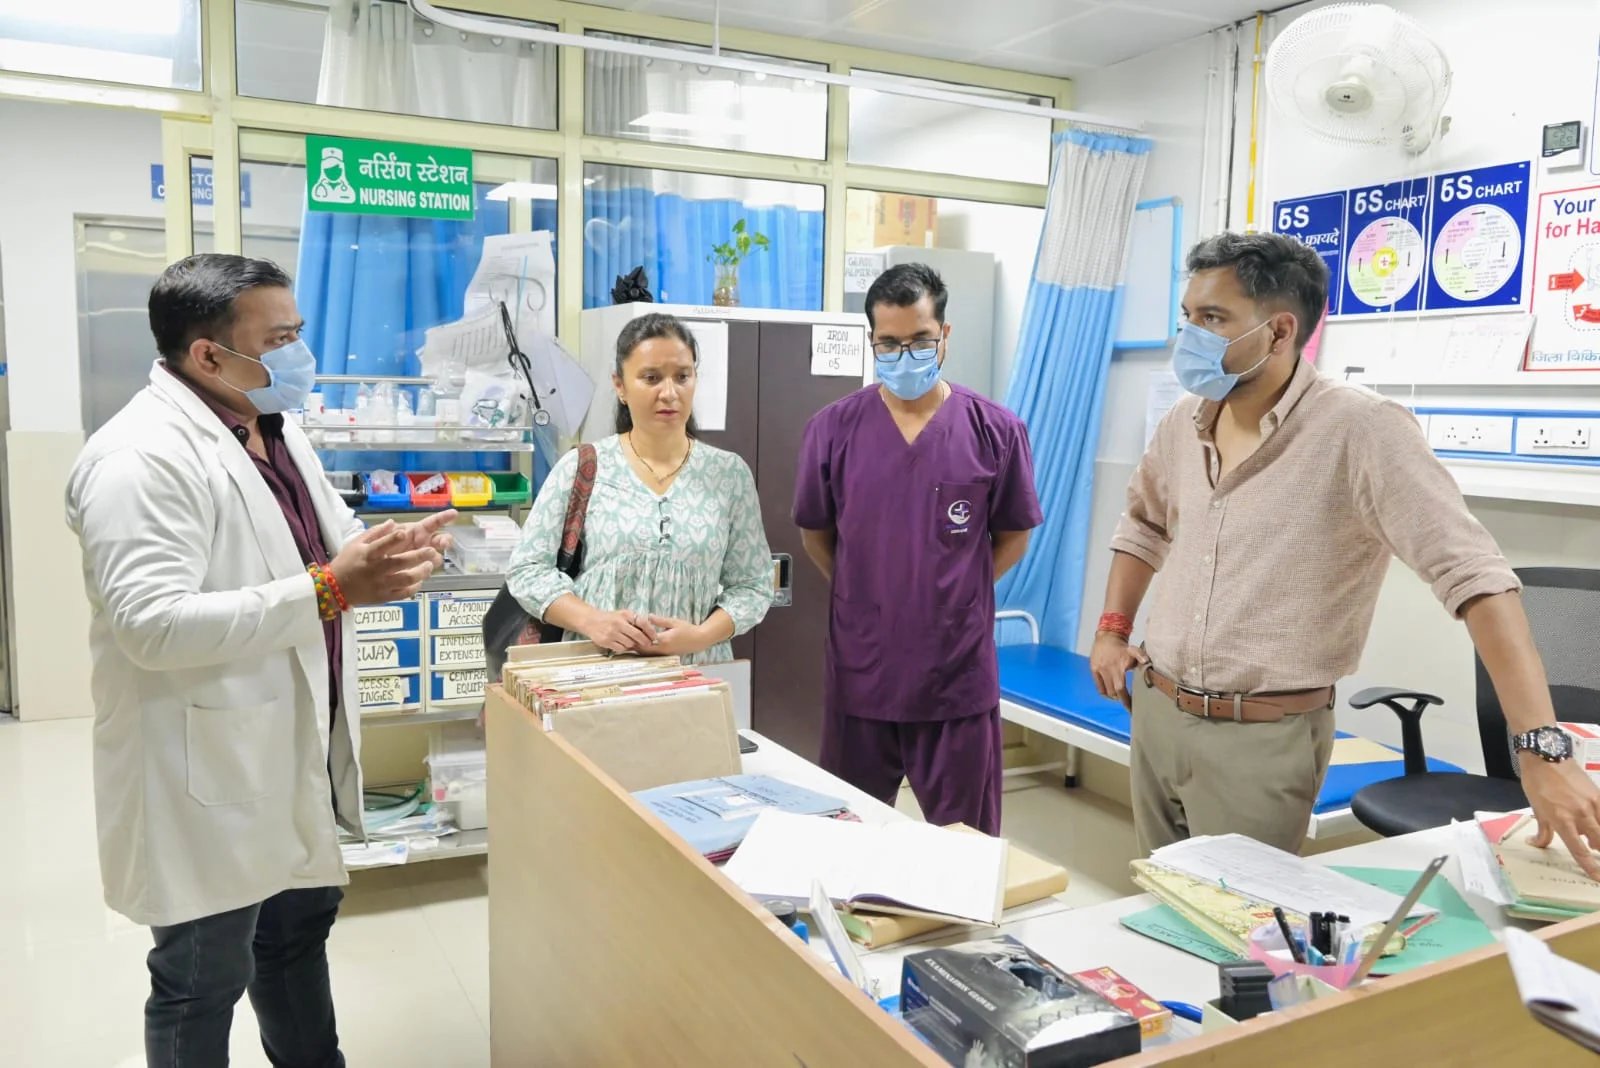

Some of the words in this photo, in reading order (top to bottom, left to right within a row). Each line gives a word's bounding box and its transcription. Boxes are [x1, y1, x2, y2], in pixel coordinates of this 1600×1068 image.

[358, 152, 412, 181] नर्सिंग
[416, 155, 469, 185] स्टेशन
[1475, 180, 1523, 199] CHART
[359, 188, 417, 208] NURSING
[419, 191, 470, 211] STATION
[1384, 194, 1426, 212] CHART
[1553, 198, 1597, 216] Your
[1545, 222, 1571, 239] for
[827, 330, 849, 342] IRON
[816, 342, 860, 356] ALMIRAH
